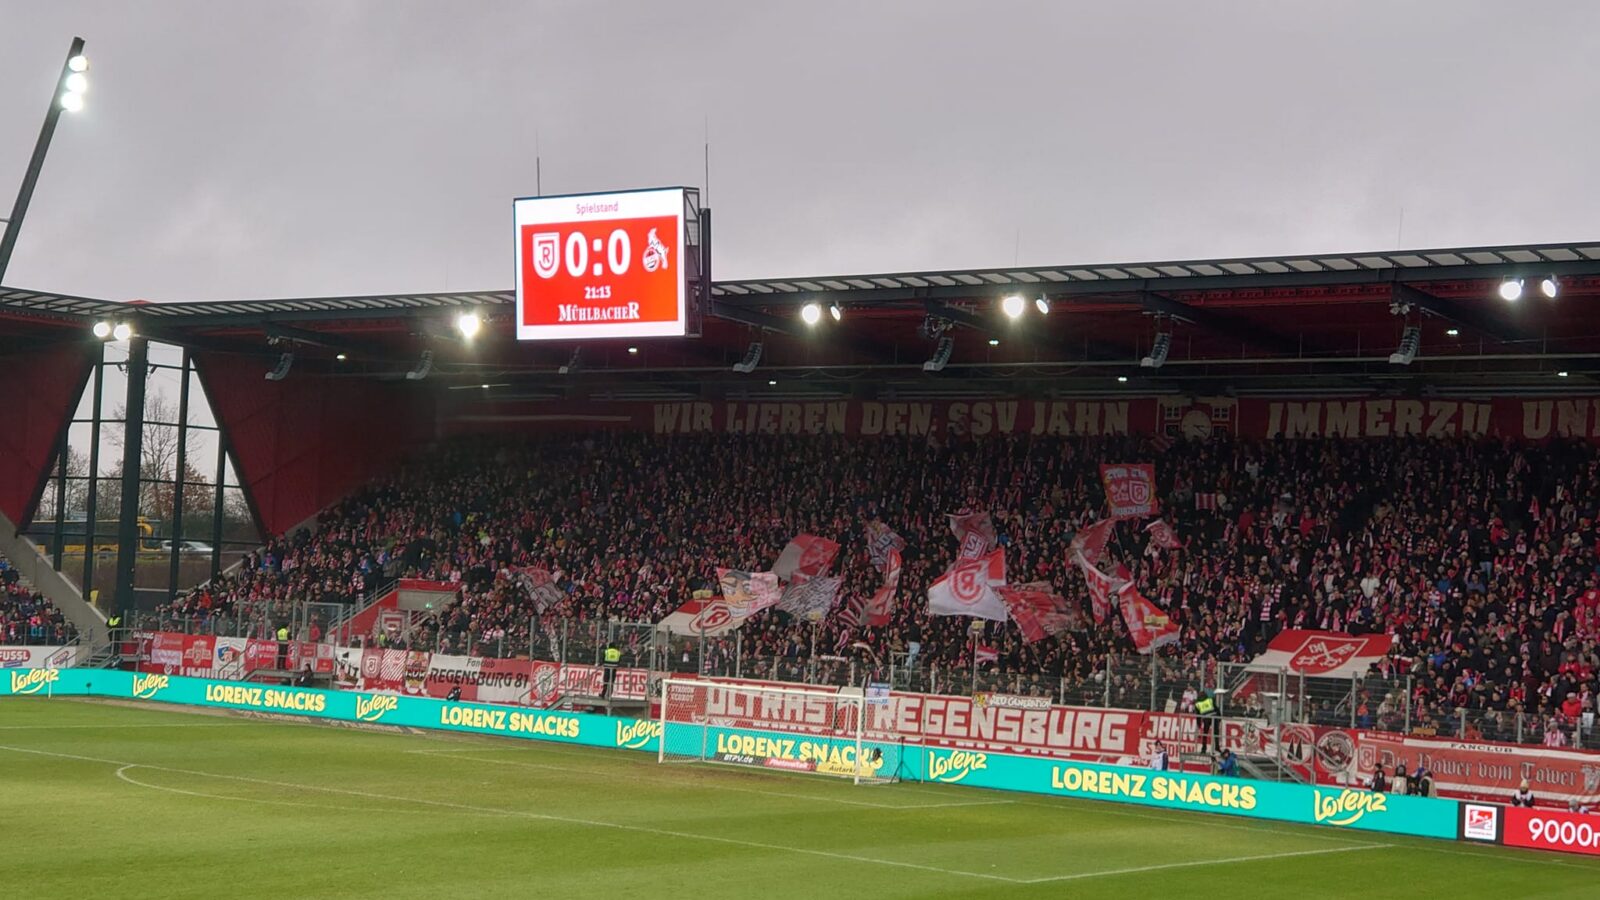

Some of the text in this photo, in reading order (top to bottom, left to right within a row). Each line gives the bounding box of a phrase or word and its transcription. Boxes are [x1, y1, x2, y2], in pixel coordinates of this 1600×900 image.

[576, 201, 619, 216] Spielstand
[565, 229, 631, 277] 0:0
[584, 285, 612, 299] 21:13
[558, 301, 640, 322] MÜHLBACHER
[654, 401, 713, 434] WIR
[726, 401, 848, 434] LIEBEN
[861, 401, 933, 436] DEN
[947, 400, 1019, 434] SSV
[1031, 401, 1130, 437] JAHN
[1266, 400, 1492, 438] IMMERZU
[11, 668, 60, 693] Lorenz
[133, 673, 168, 698] Lorenz
[430, 667, 530, 689] REGENSBURG 81
[206, 684, 326, 712] LORENZ SNACKS
[356, 693, 397, 721] Lorenz
[441, 706, 579, 737] LORENZ SNACKS
[706, 681, 1129, 751] ULTRAS REGENSBURG
[616, 718, 662, 748] Lorenz
[718, 733, 795, 760] LORENZ
[1146, 716, 1197, 757] JAHN SDION
[1450, 743, 1513, 753] FANCLUB
[929, 750, 987, 781] Lorenz
[1520, 761, 1577, 786] Tower
[1052, 766, 1256, 810] LORENZ SNACKS
[1314, 789, 1387, 826] Lorenz
